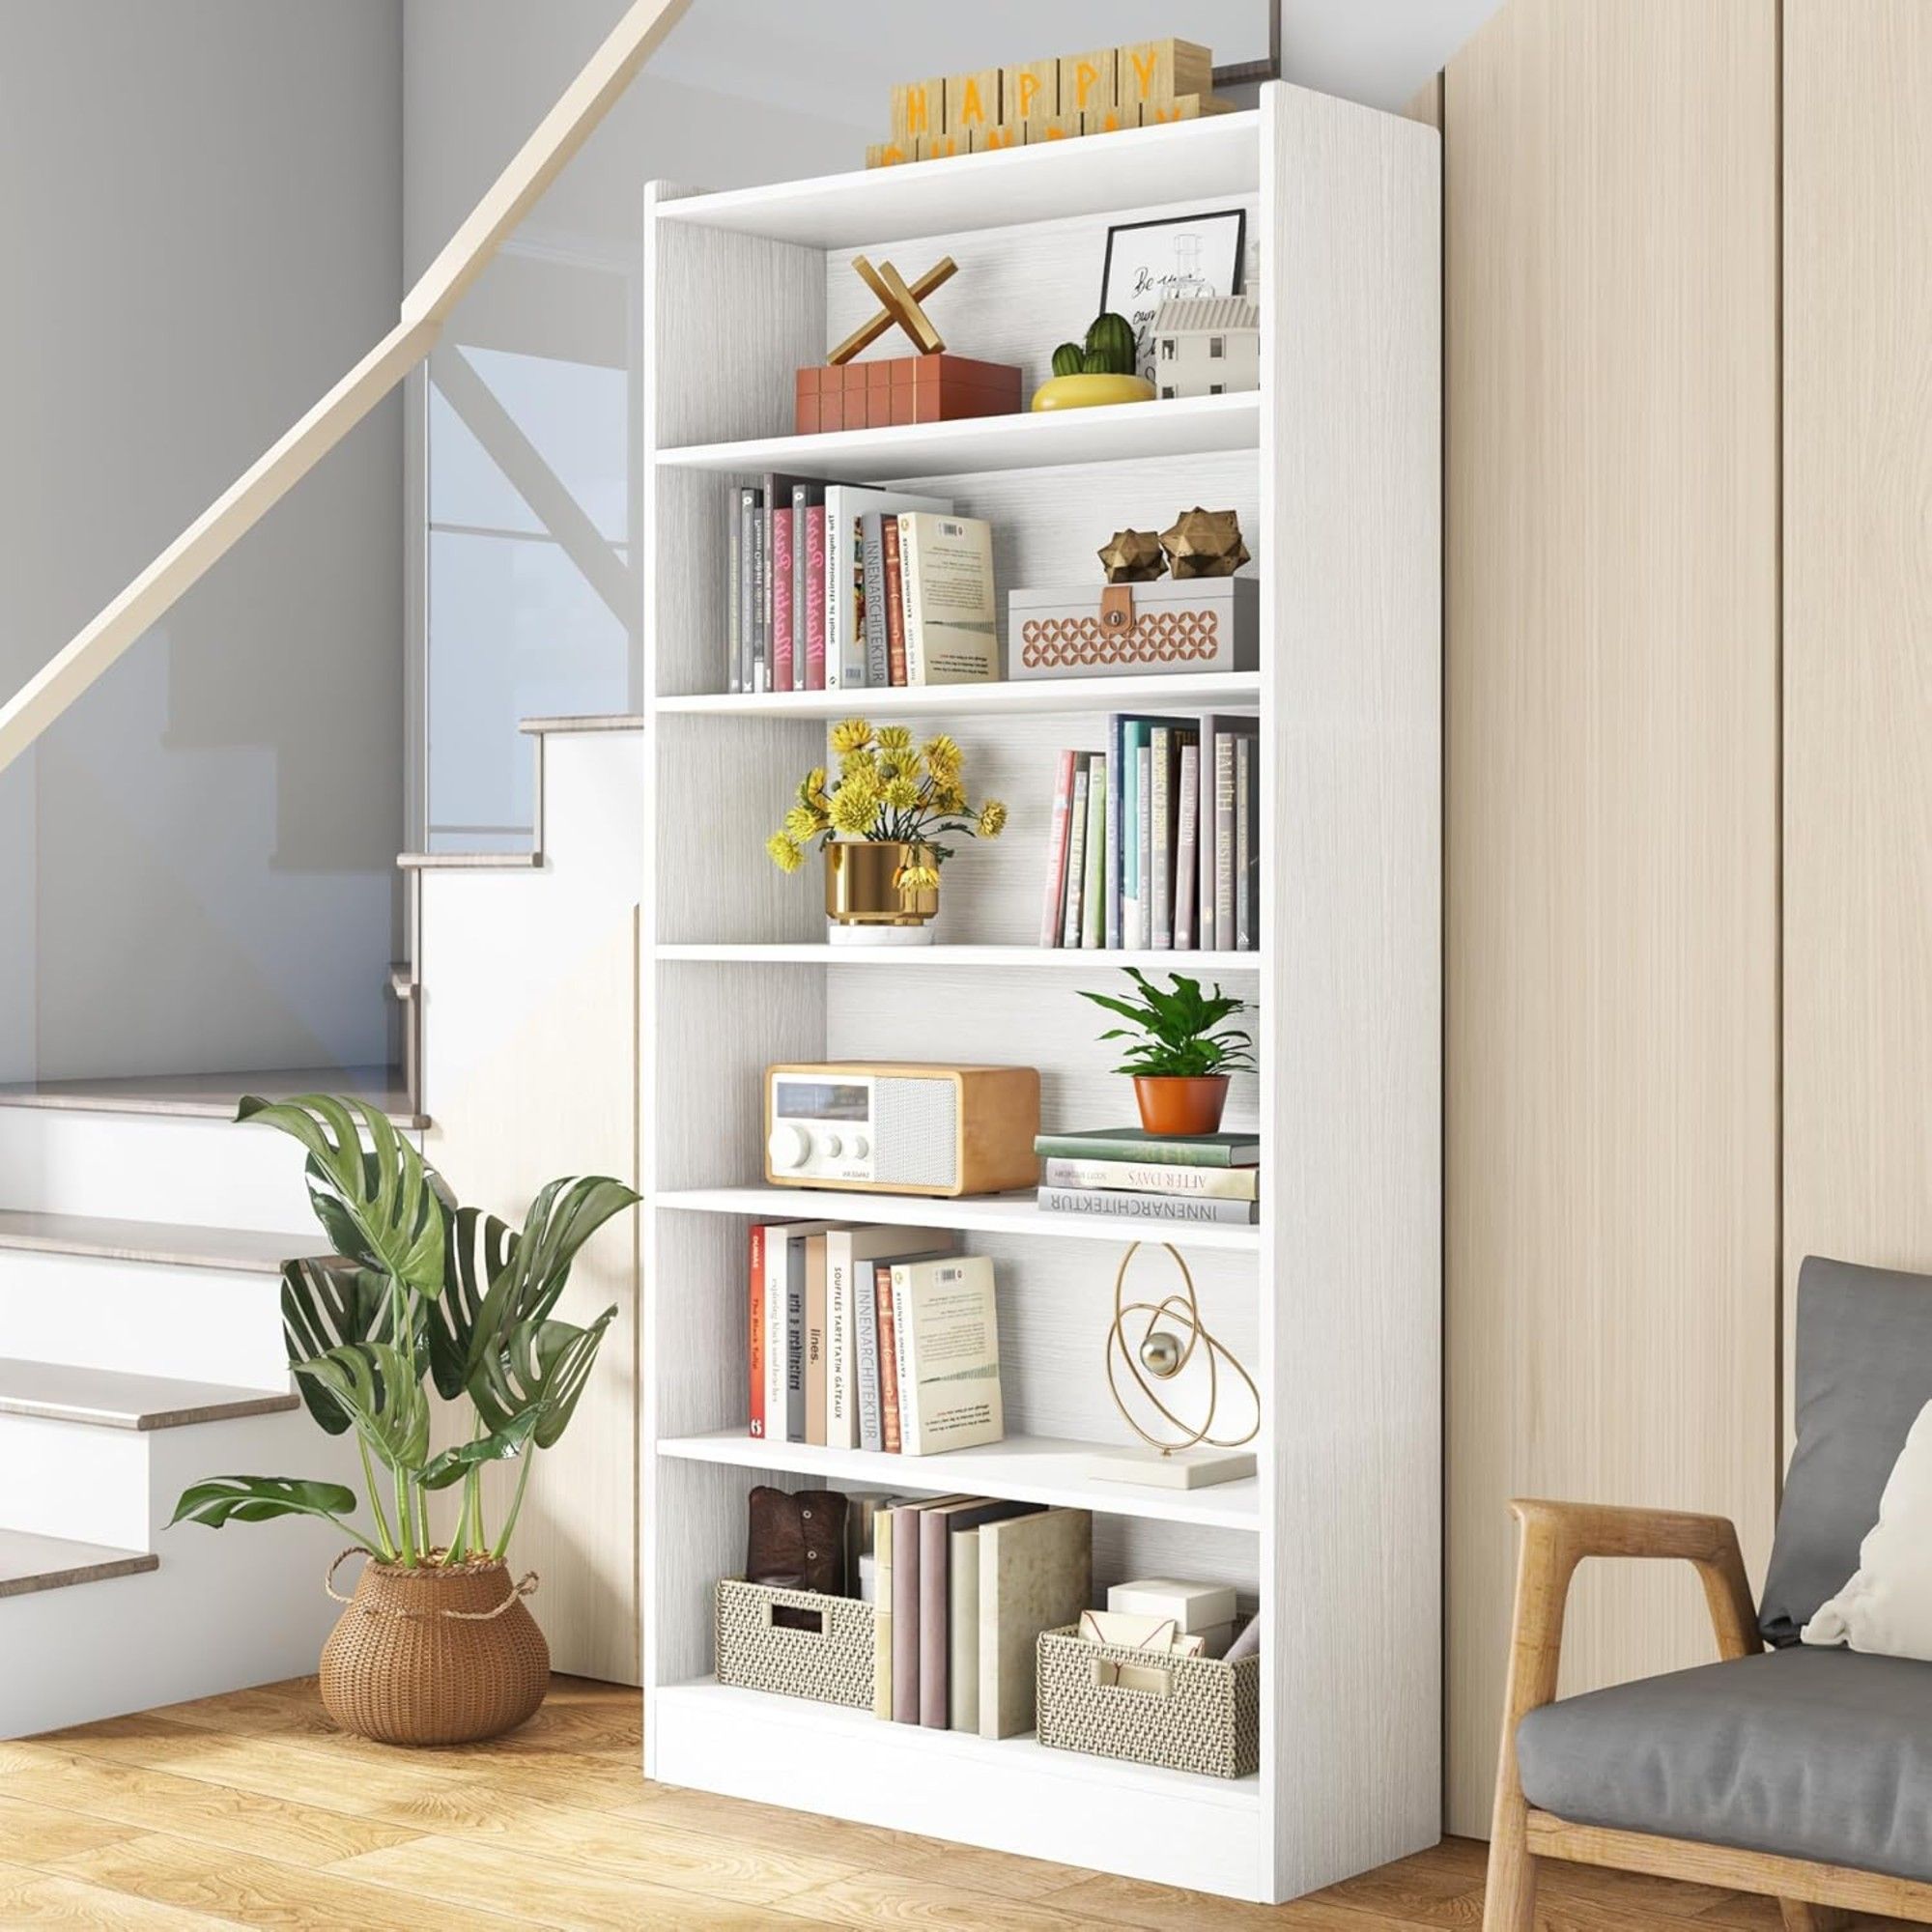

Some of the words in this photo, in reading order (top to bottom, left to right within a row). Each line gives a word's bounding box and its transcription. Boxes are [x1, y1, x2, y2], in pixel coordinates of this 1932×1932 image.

[906, 49, 1156, 134] HAPPY
[867, 540, 884, 681] INNENARCHITEKTUR
[1128, 1172, 1165, 1186] DAYS
[1167, 1175, 1206, 1189] AFTER
[1051, 1194, 1217, 1220] INNENARCHITEKTUR
[789, 1293, 800, 1313] arts
[834, 1315, 842, 1343] TARTE
[789, 1330, 801, 1390] architecture
[810, 1328, 820, 1364] lines.
[834, 1347, 842, 1373] TATIN
[858, 1289, 877, 1439] INNENARCHITEKTUR
